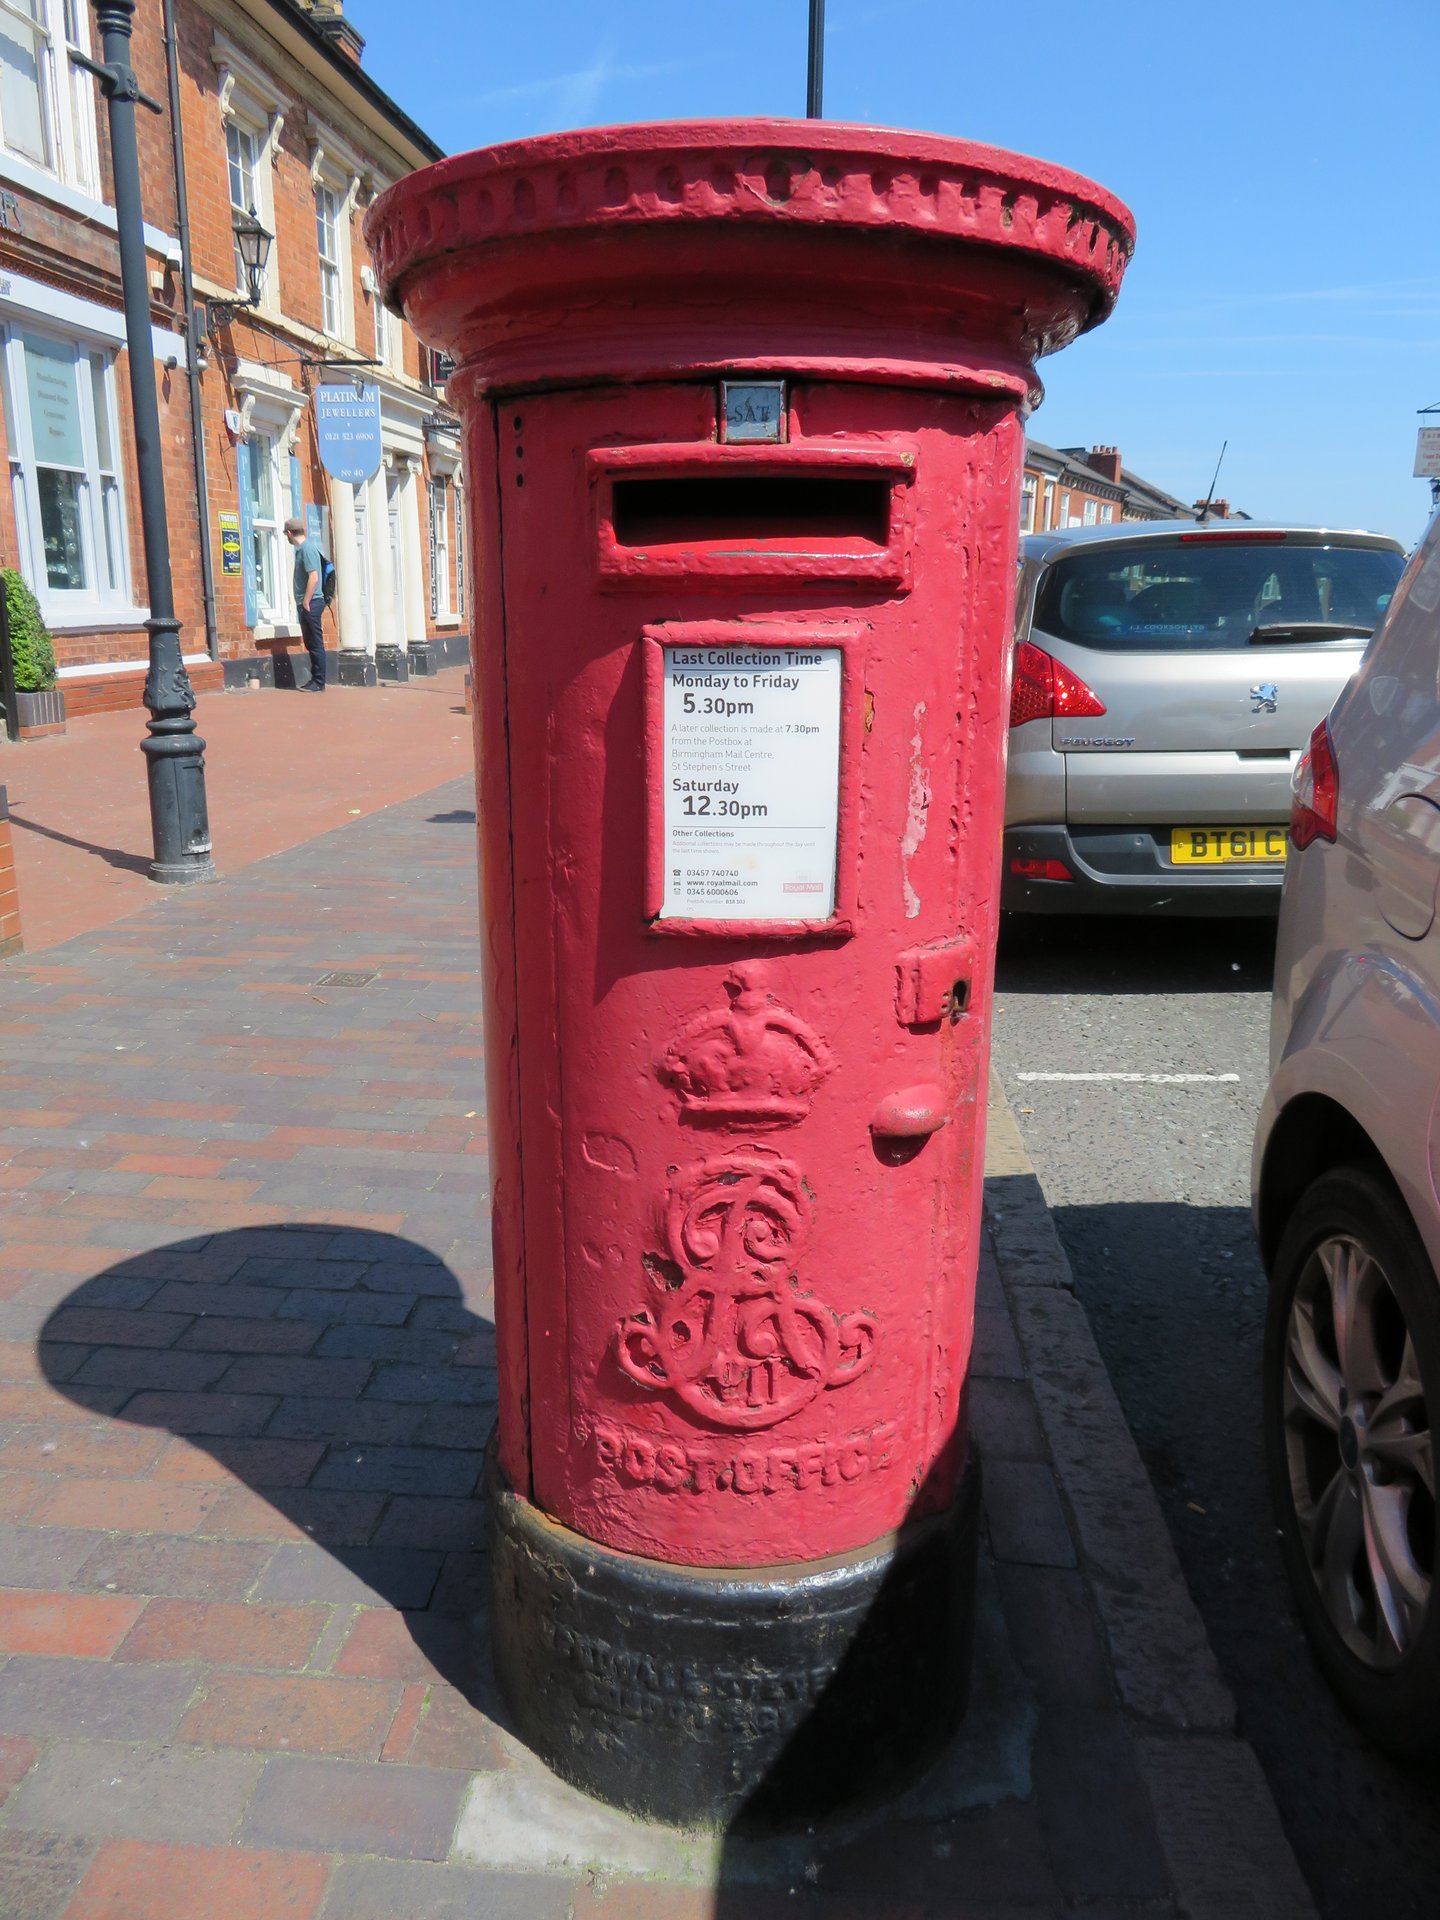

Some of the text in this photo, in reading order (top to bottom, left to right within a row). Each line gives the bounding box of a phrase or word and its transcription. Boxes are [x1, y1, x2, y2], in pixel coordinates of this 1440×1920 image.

[321, 408, 376, 419] JEWELLERS
[734, 405, 770, 422] SAT
[324, 433, 339, 441] 0121
[342, 433, 354, 441] 523
[672, 652, 822, 665] Last Collection Time
[673, 674, 800, 691] Monday to Friday
[683, 693, 754, 717] 5.30pm
[671, 724, 678, 732] A
[679, 724, 698, 732] later
[700, 724, 739, 733] collection
[741, 725, 748, 733] is
[749, 724, 773, 733] made
[785, 725, 820, 735] 7.30pm
[671, 737, 752, 746] from the Postbox at
[1060, 736, 1136, 746] PEUGEOT
[672, 750, 723, 759] Birmingham
[726, 750, 742, 758] Mail
[672, 763, 751, 772] St Stephen's Street
[673, 778, 739, 794] Saturday
[682, 795, 768, 819] 12.30pm
[694, 830, 735, 838] Collections
[1191, 831, 1255, 857] BT61
[686, 869, 739, 877] 03457 740740
[686, 879, 758, 888] www.royalmail.com
[686, 888, 739, 896] 0345 6000606
[597, 1420, 896, 1494] POST OFFICE
